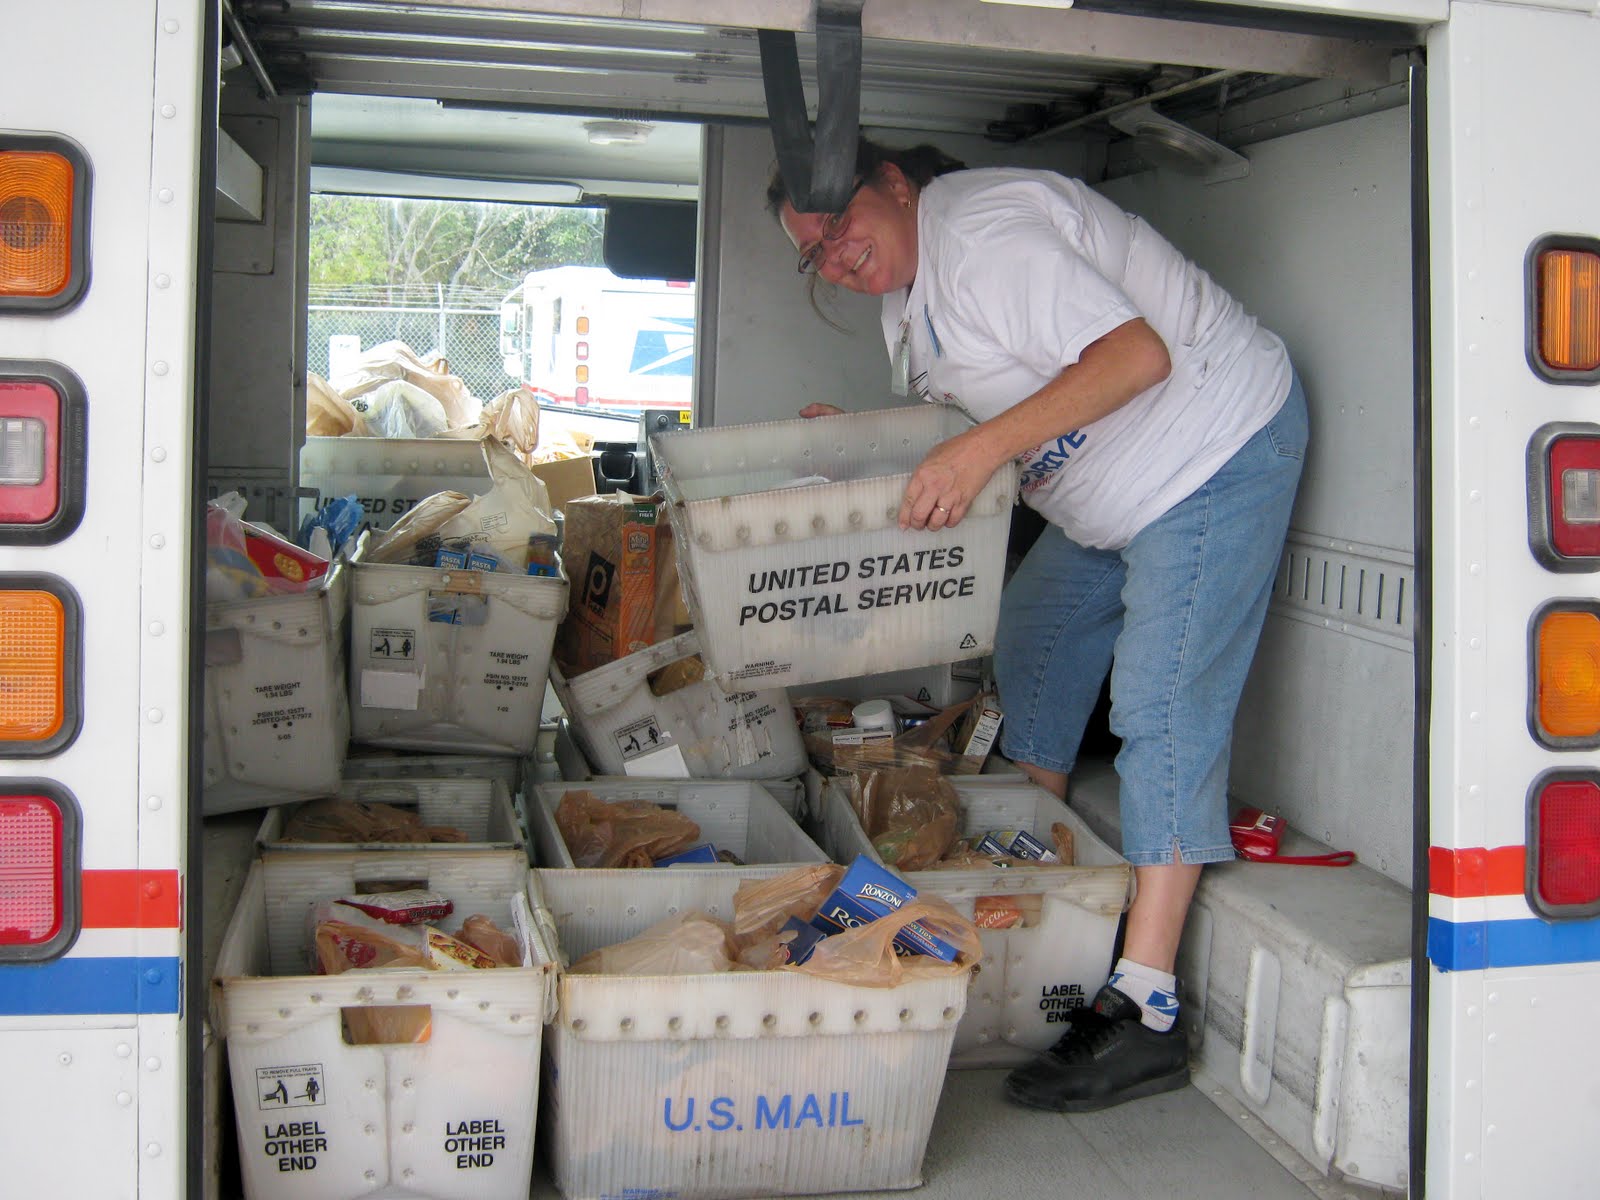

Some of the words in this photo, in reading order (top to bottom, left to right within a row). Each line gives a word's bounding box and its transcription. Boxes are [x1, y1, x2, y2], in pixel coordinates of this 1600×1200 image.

[441, 555, 461, 564] PASTA
[471, 560, 492, 570] PASTA
[749, 561, 850, 594] UNITED
[858, 546, 965, 579] STATES
[739, 593, 849, 626] POSTAL
[857, 576, 976, 611] SERVICE
[489, 651, 505, 659] TARE
[745, 660, 775, 669] WARNING
[255, 685, 273, 693] TARE
[273, 682, 301, 691] WEIGHT
[861, 883, 903, 908] RONZONI
[1041, 984, 1085, 997] LABEL
[1039, 997, 1085, 1010] OTHER
[664, 1096, 744, 1132] U.S.
[754, 1091, 864, 1130] MAIL
[264, 1121, 326, 1139] LABEL
[446, 1119, 505, 1136] LABEL
[264, 1137, 328, 1156] OTHER
[444, 1135, 506, 1153] OTHER
[278, 1155, 317, 1172] END
[456, 1153, 494, 1169] END
